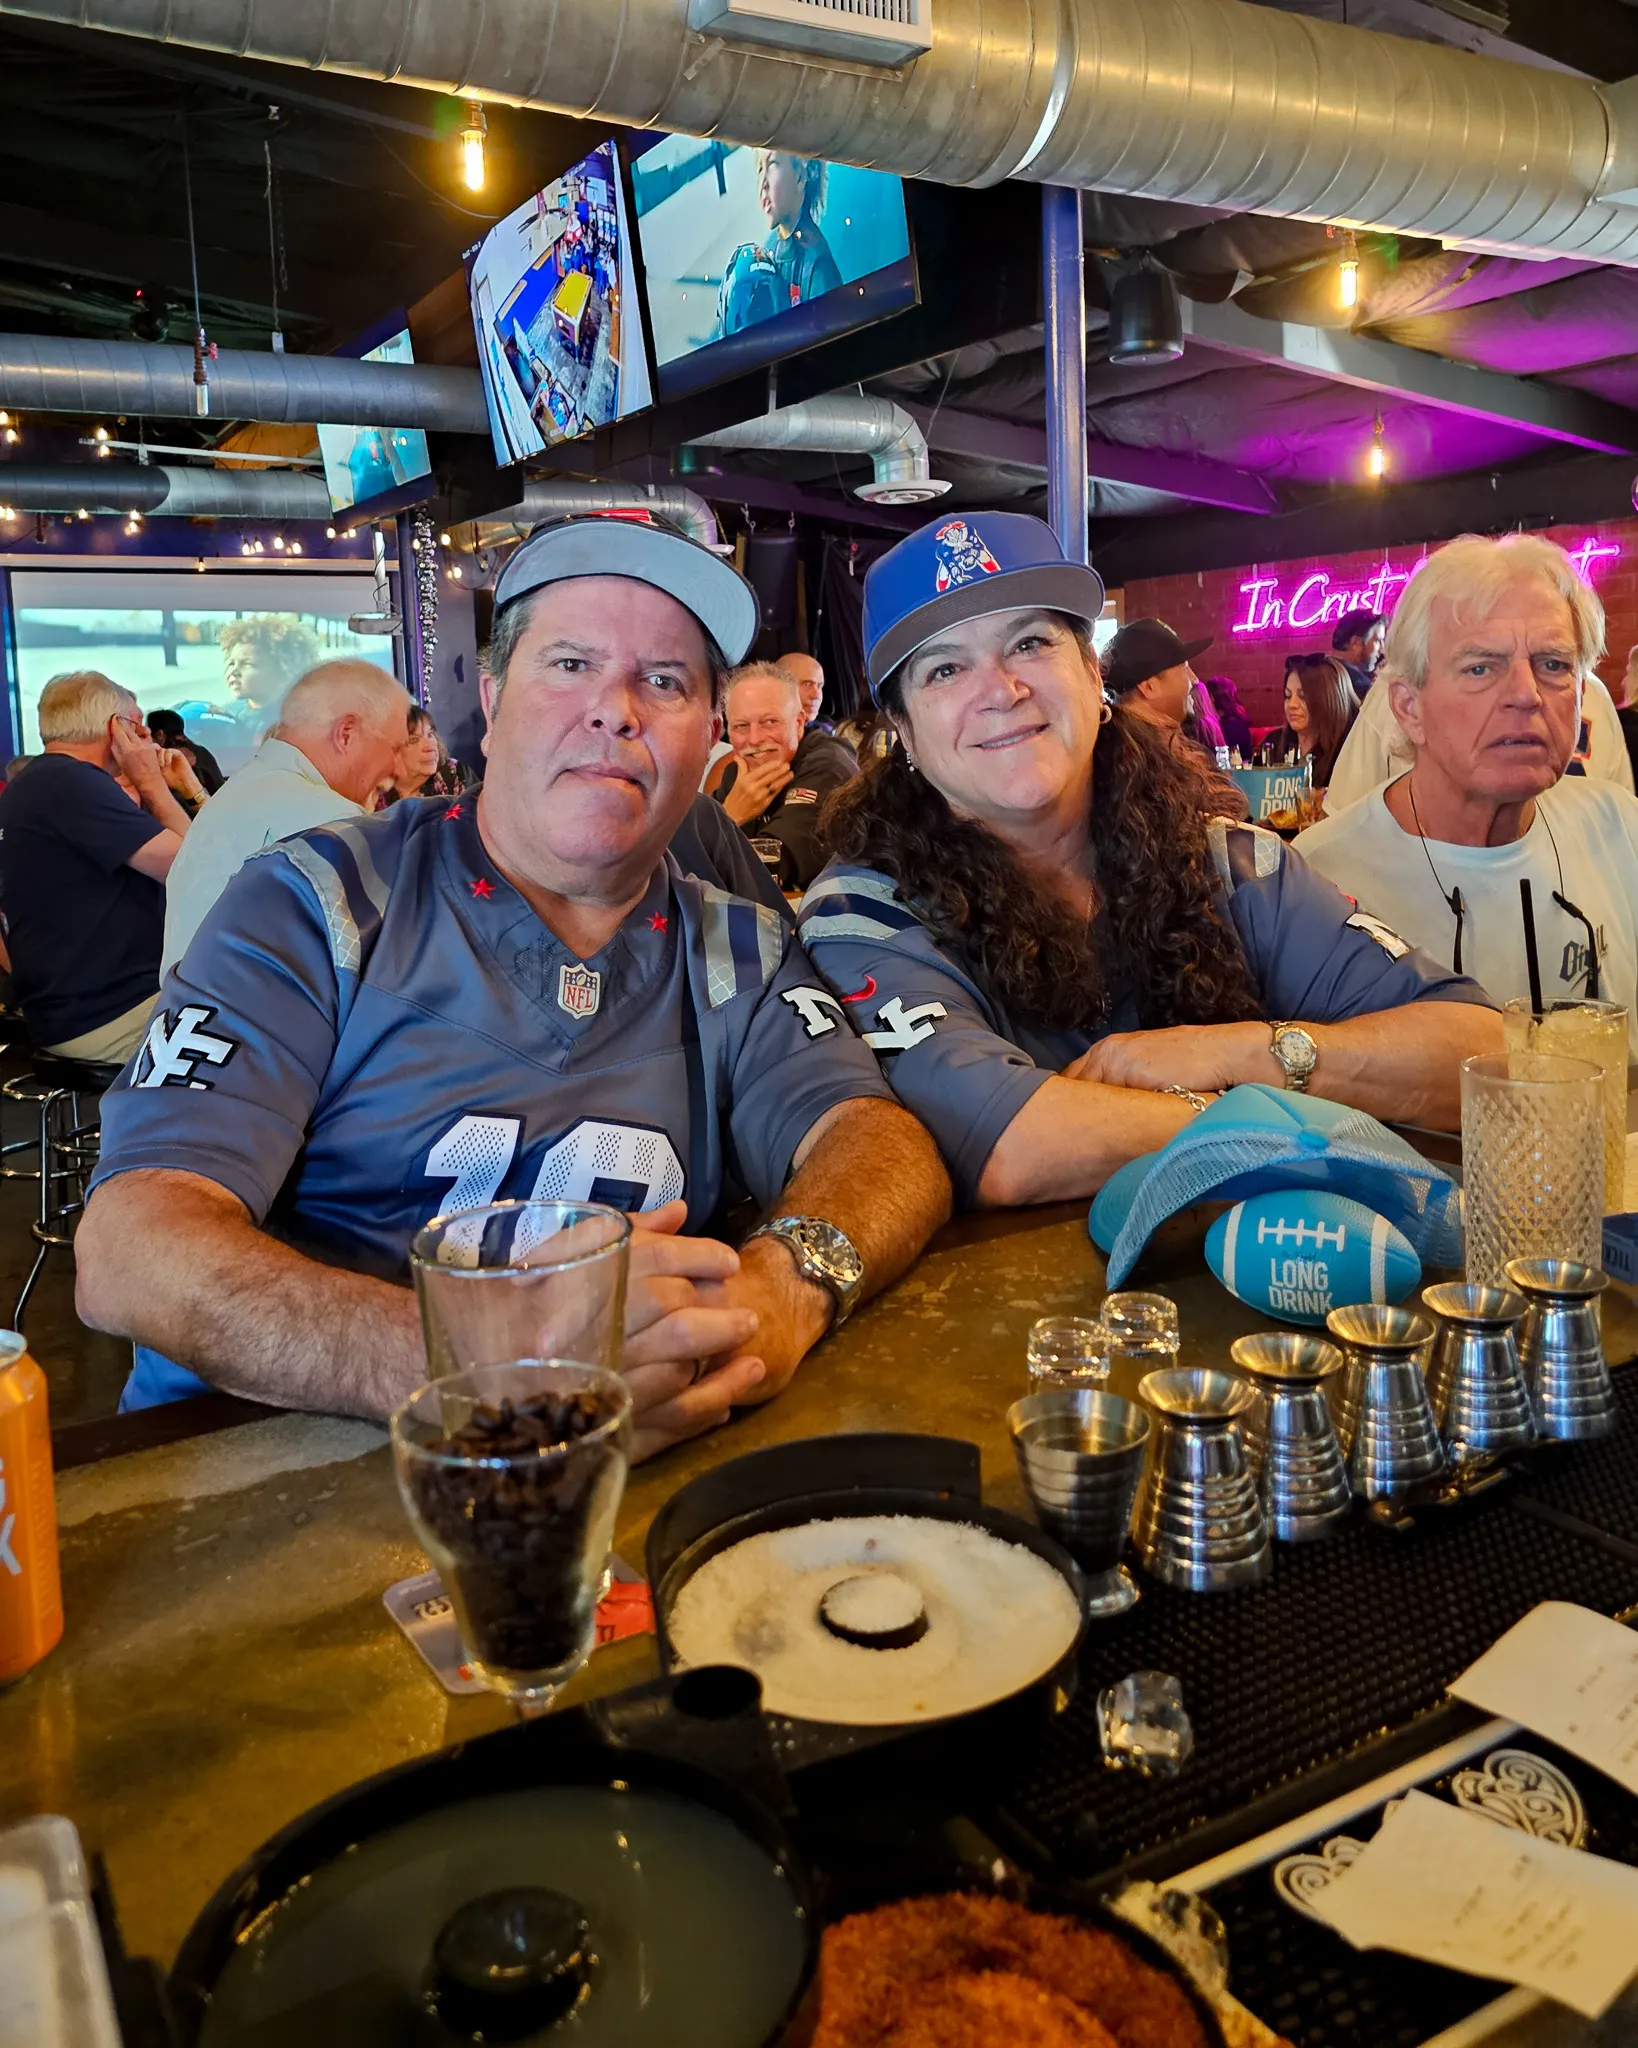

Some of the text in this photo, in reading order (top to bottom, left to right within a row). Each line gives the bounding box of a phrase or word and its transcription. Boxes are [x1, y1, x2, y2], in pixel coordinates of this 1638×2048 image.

[1232, 571, 1409, 632] In Crust
[1260, 798, 1297, 821] DRIN
[565, 986, 593, 1009] NFL
[1271, 1258, 1328, 1291] LONG
[1269, 1286, 1333, 1315] DRINK
